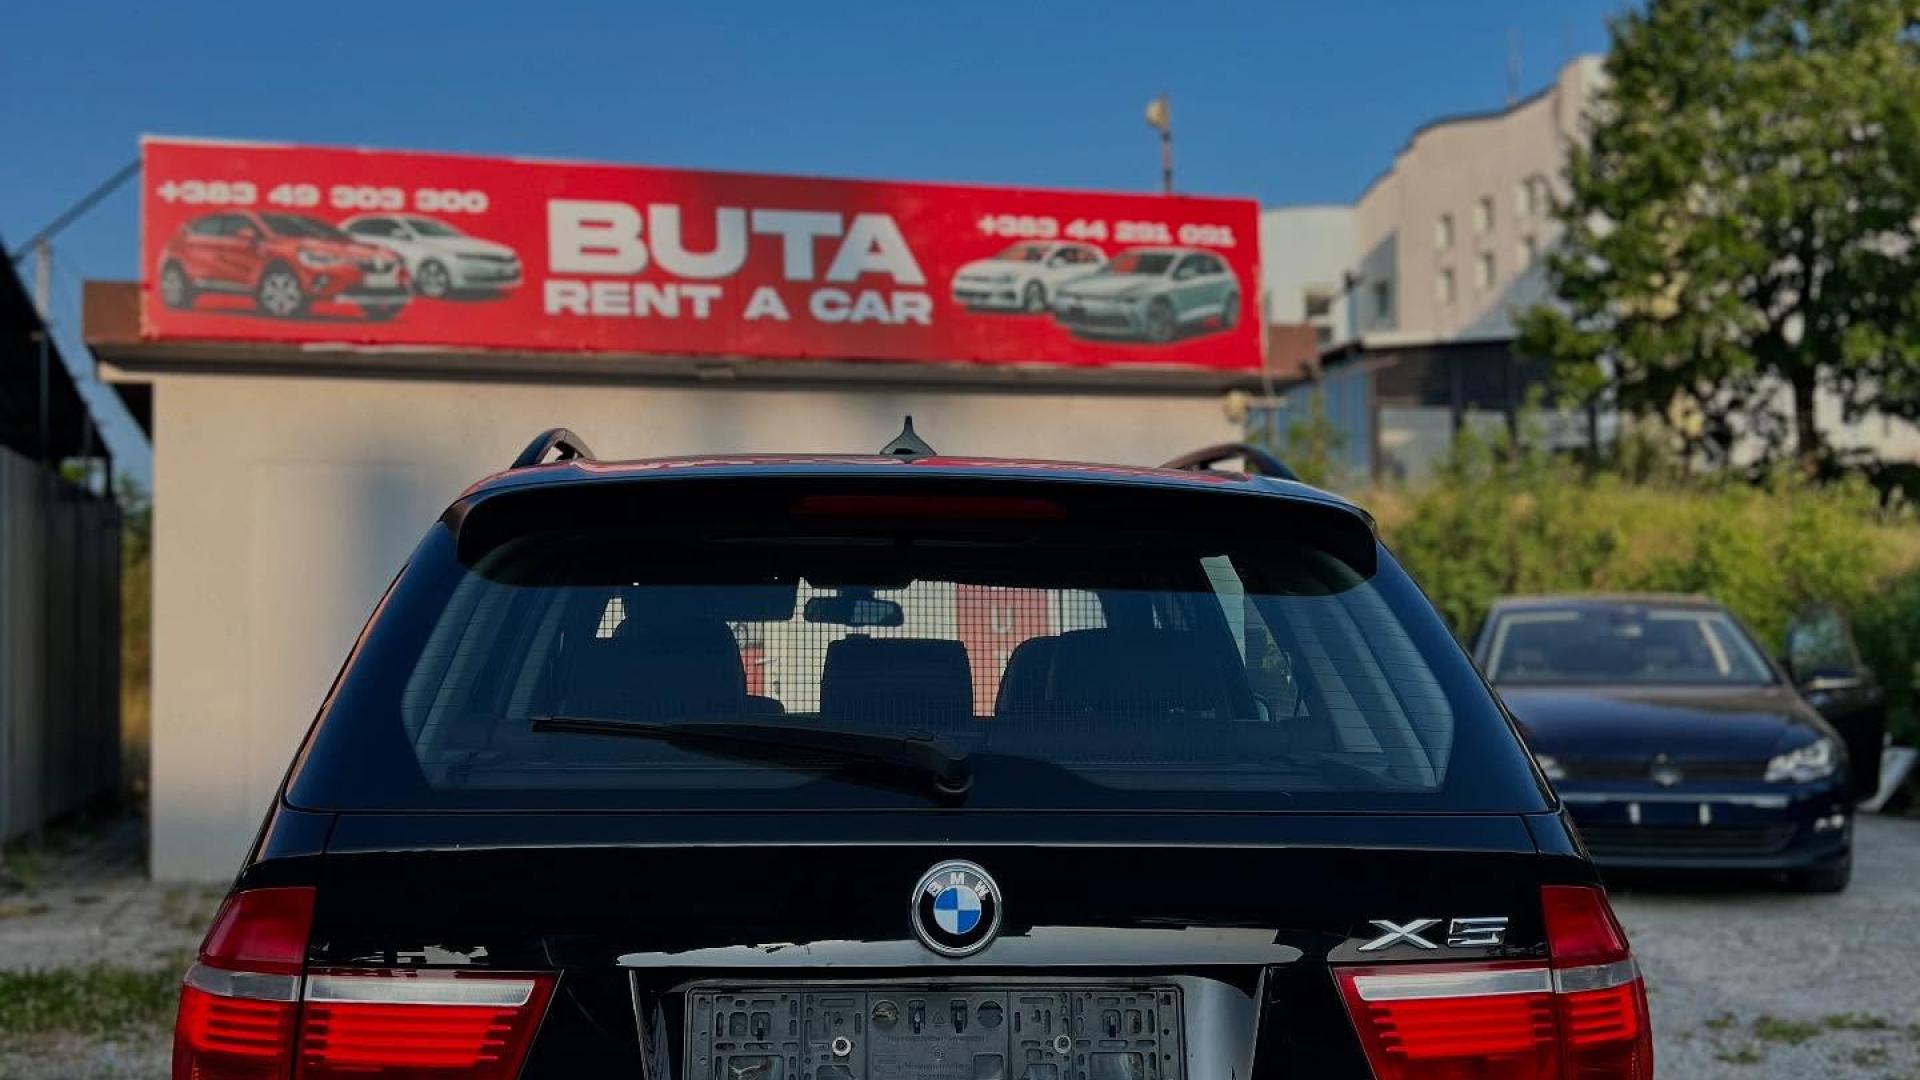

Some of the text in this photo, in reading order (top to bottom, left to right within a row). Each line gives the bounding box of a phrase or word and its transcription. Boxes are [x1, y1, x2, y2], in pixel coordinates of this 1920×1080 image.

[156, 180, 488, 213] +383 49 303 300
[547, 199, 927, 285] BUTA
[977, 213, 1058, 237] +383
[1064, 219, 1107, 240] 44
[544, 280, 934, 324] RENT A CAR
[926, 871, 990, 900] BMW
[1357, 917, 1508, 950] X5
